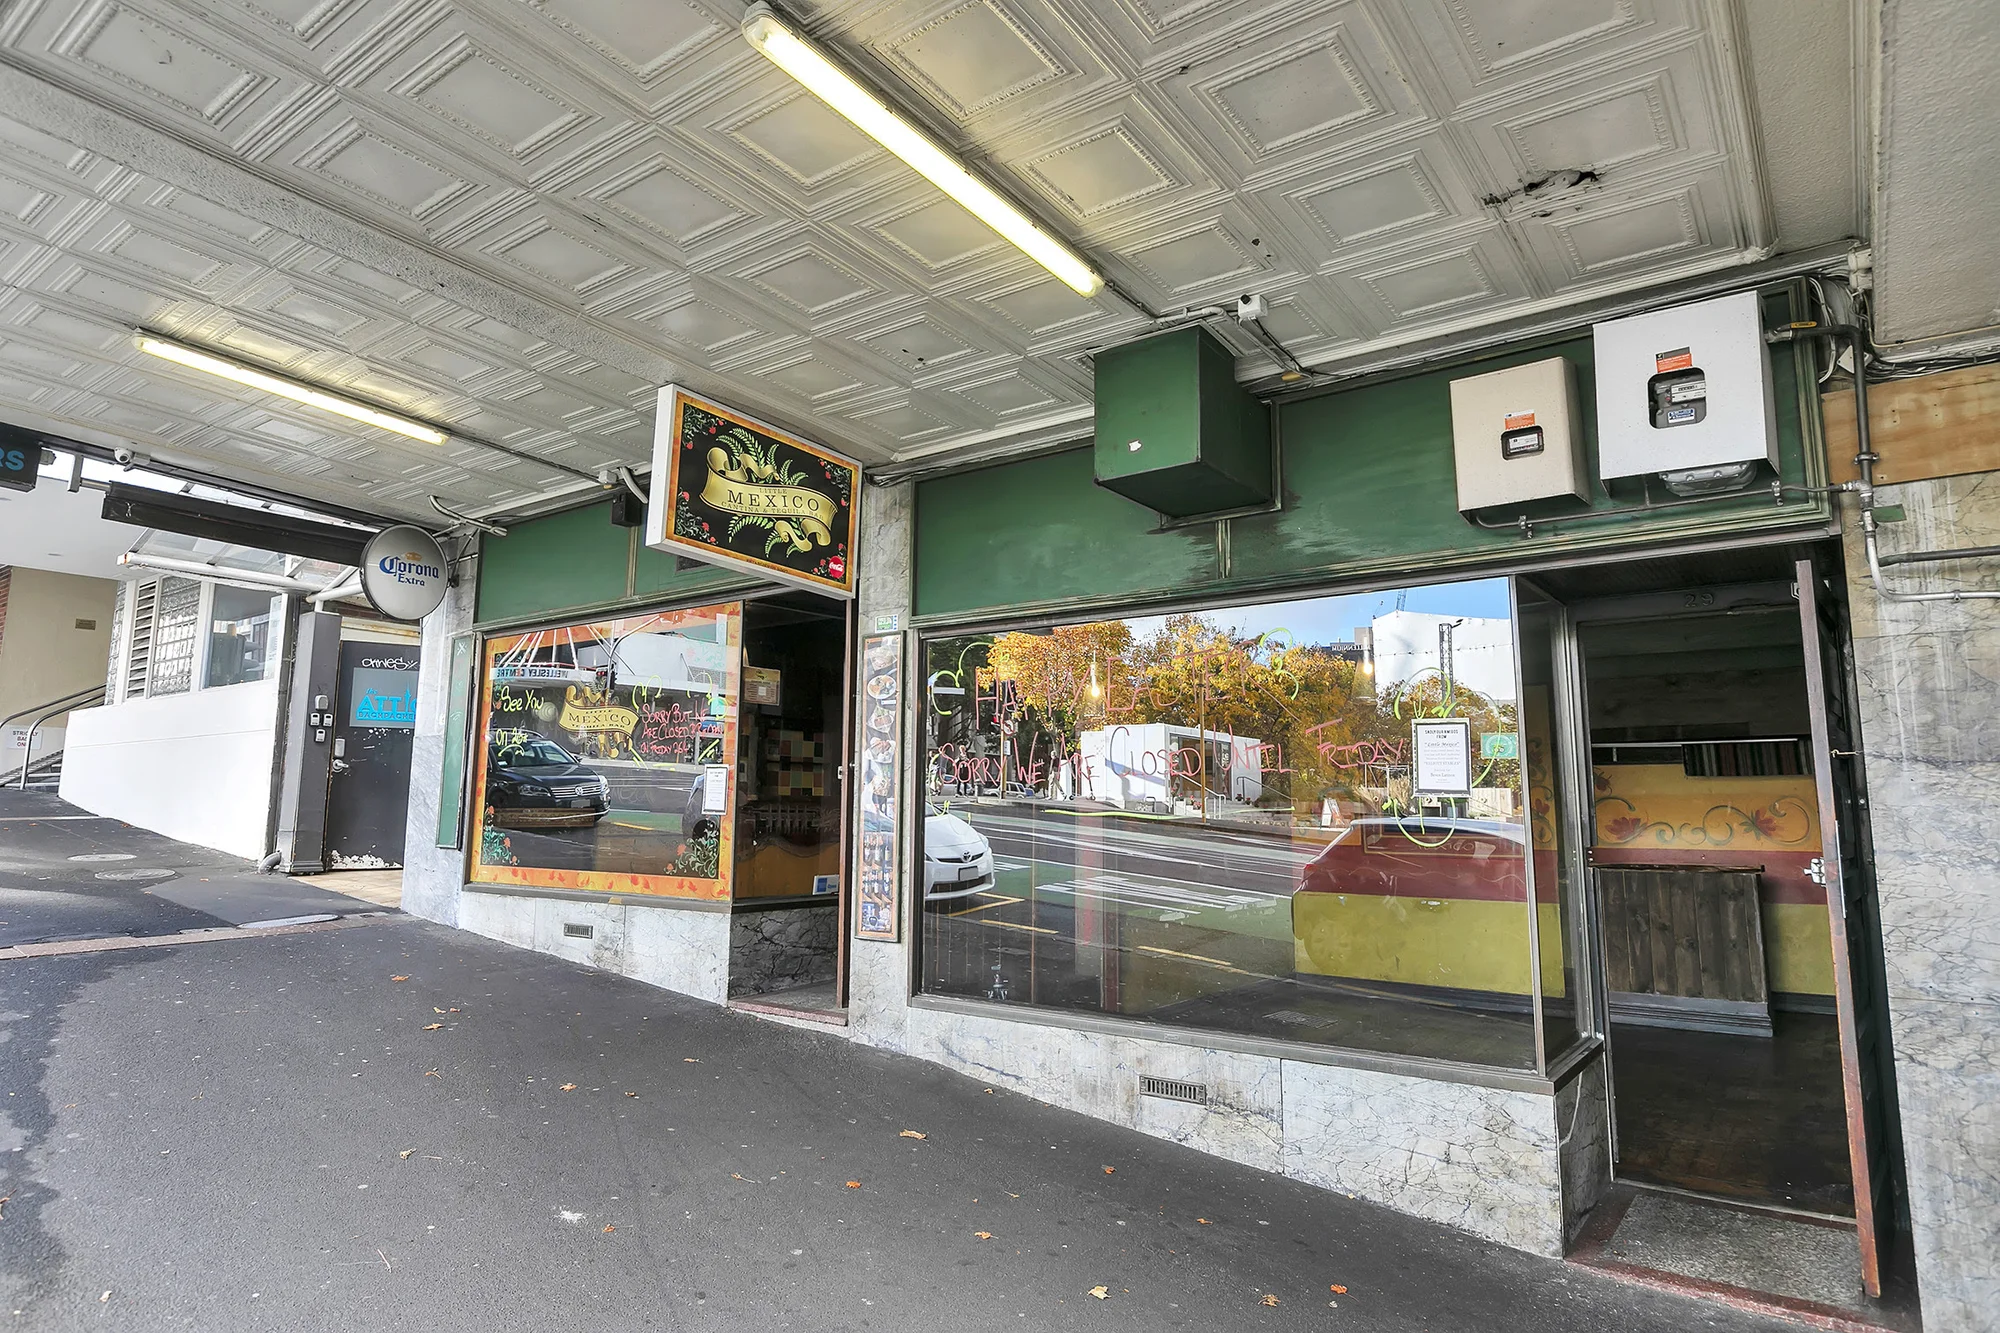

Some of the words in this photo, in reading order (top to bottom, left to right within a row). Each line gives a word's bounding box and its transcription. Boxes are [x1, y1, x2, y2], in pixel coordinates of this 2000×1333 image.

[727, 490, 819, 511] MEXICO
[379, 555, 439, 579] Corona
[398, 573, 425, 586] Extra
[525, 689, 545, 711] You
[357, 711, 416, 721] BACKPACKE
[568, 713, 631, 726] MEXICO
[939, 742, 1007, 787] SORRY
[1013, 731, 1048, 786] WE
[1057, 731, 1100, 782] ARE
[1109, 726, 1202, 778] CLOSED
[1212, 723, 1299, 774] UNTIL
[1305, 718, 1404, 770] FRIDAY
